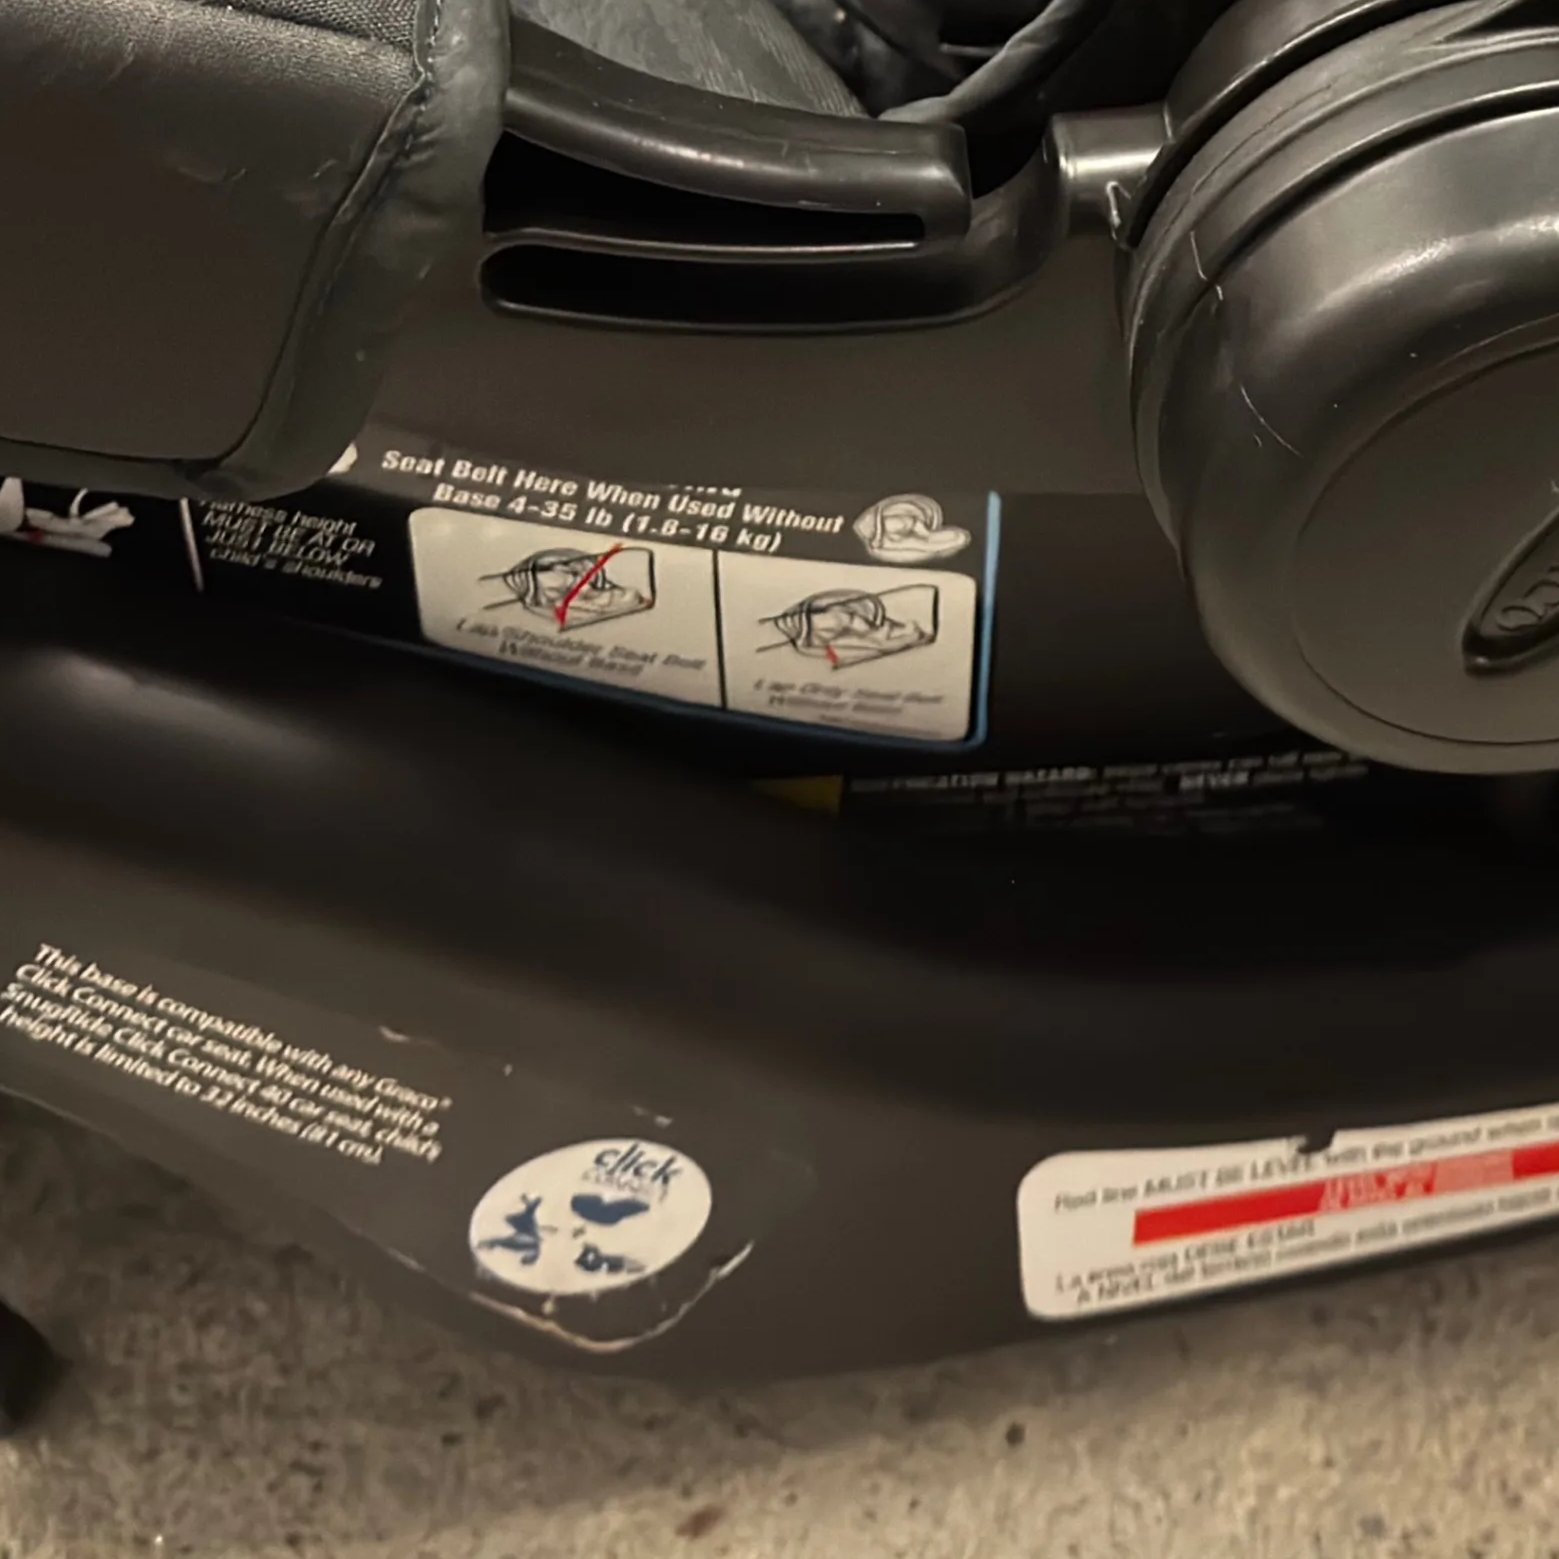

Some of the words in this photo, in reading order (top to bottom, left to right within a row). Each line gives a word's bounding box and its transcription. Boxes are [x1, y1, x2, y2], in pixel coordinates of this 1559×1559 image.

[382, 450, 444, 475] Seat
[451, 460, 506, 484] Belt
[513, 470, 577, 495] Here
[587, 481, 659, 508] When
[668, 494, 734, 518] Used
[743, 505, 842, 531] Without
[433, 483, 499, 508] Base
[508, 496, 576, 520] 4-35
[585, 507, 612, 526] lb
[736, 528, 781, 552] kg)
[203, 510, 268, 534] MUST
[273, 524, 304, 541] BE
[307, 530, 336, 547] AT
[341, 537, 374, 555] OR
[206, 529, 261, 549] JUST
[268, 540, 348, 565] BELOW
[16, 964, 69, 995] Click
[72, 987, 166, 1032] Connect
[166, 1026, 202, 1045] car
[256, 1056, 319, 1091] When
[320, 1085, 378, 1111] used
[374, 1104, 422, 1129] with
[421, 1121, 439, 1135] a
[36, 944, 80, 974] This
[80, 963, 137, 996] base
[136, 985, 157, 1005] is
[158, 998, 281, 1051] compatible
[283, 1045, 331, 1072] with
[331, 1065, 374, 1088] any
[0, 1006, 76, 1046] height
[73, 1035, 95, 1055] is
[95, 1044, 178, 1085] limited
[174, 1076, 200, 1094] to
[201, 1086, 233, 1106] 32
[231, 1096, 300, 1133] inches
[113, 1027, 164, 1057] Click
[168, 1048, 259, 1093] Connect
[288, 1098, 323, 1115] car
[594, 1140, 682, 1186] click
[1144, 1171, 1206, 1196] MUST
[1216, 1167, 1241, 1185] BE
